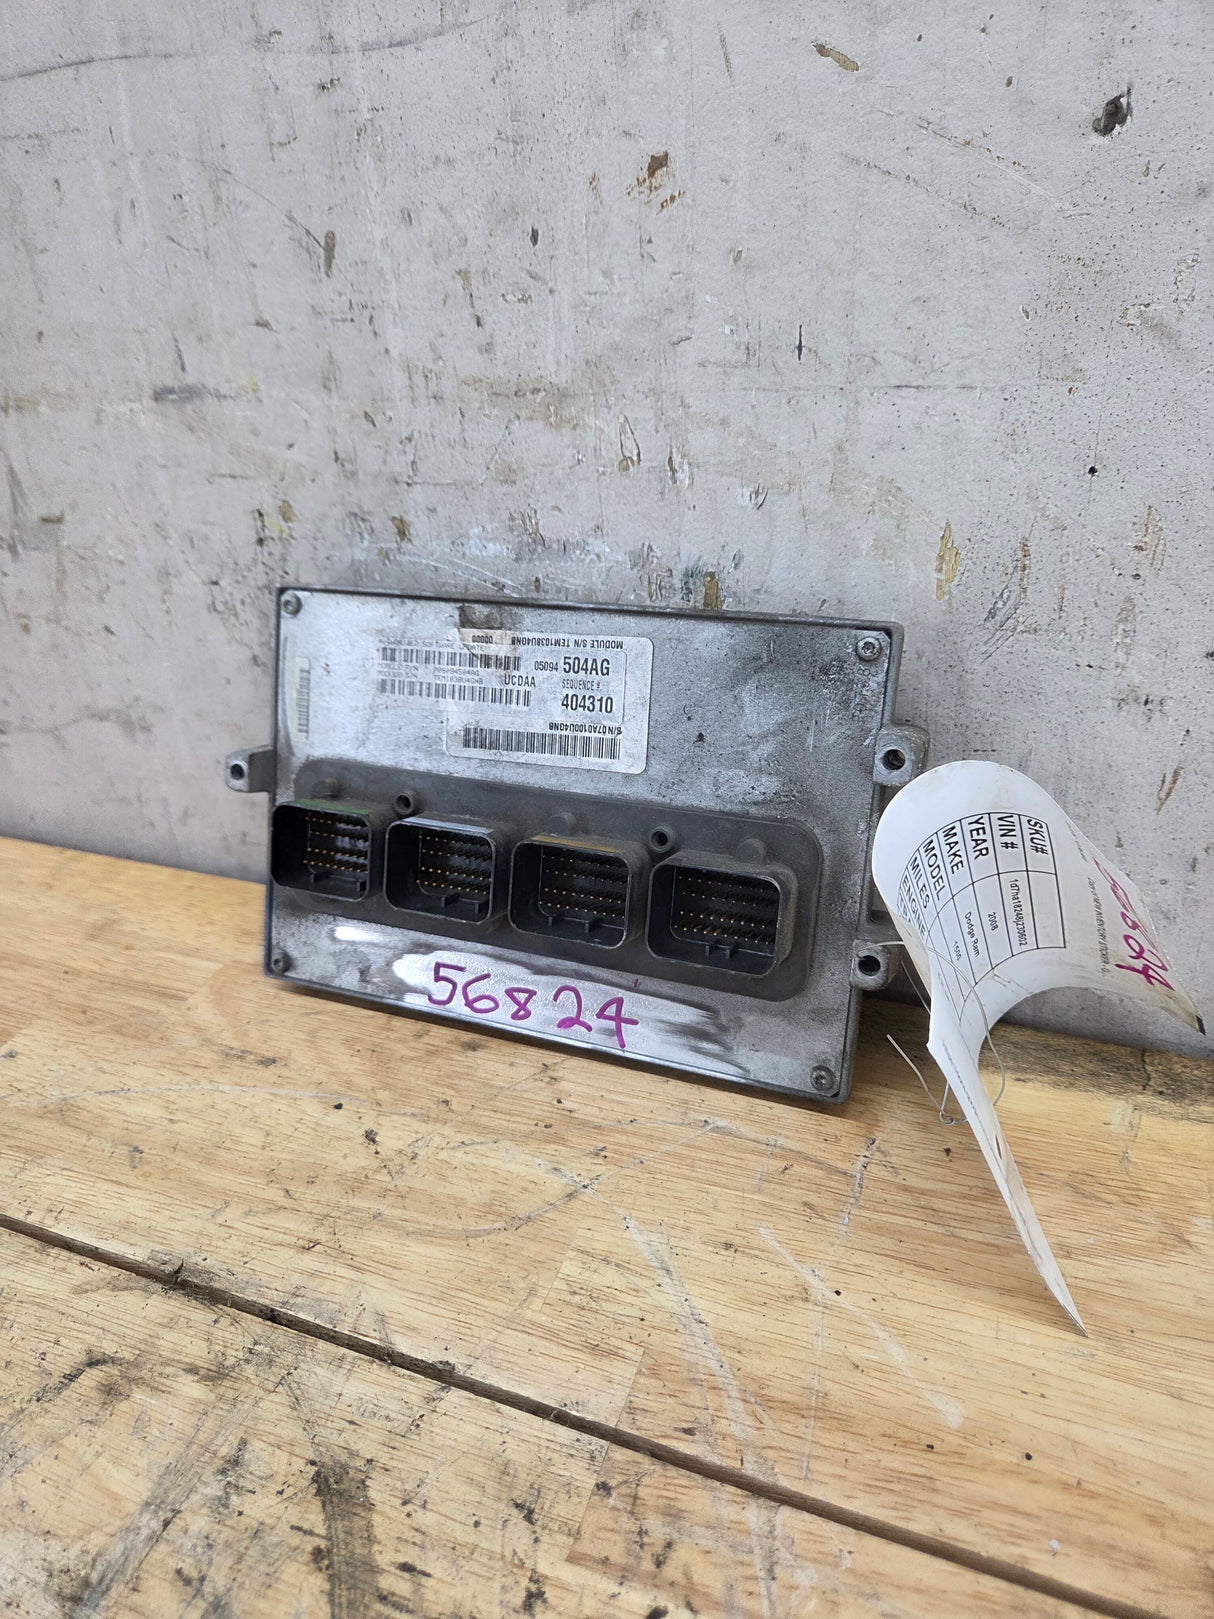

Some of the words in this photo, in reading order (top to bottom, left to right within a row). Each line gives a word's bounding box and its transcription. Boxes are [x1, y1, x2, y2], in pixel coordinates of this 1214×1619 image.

[574, 638, 588, 648] S/N
[590, 640, 624, 650] MODULE
[504, 674, 536, 688] UCDAA
[534, 660, 559, 673] 05094
[563, 656, 610, 677] 504AG
[562, 678, 595, 692] SEQUENCE
[561, 693, 614, 714] 404310
[968, 816, 990, 860] YEAR
[997, 815, 1016, 838] VIN
[1027, 818, 1049, 856] SKU#
[942, 825, 964, 875] MAKE
[909, 856, 930, 910] MILES
[922, 838, 946, 901] MODEL
[902, 874, 926, 937] ENGINE
[964, 911, 976, 940] Dodge
[971, 938, 980, 958] Ram
[987, 912, 999, 932] 2008
[427, 961, 640, 1050] 56824
